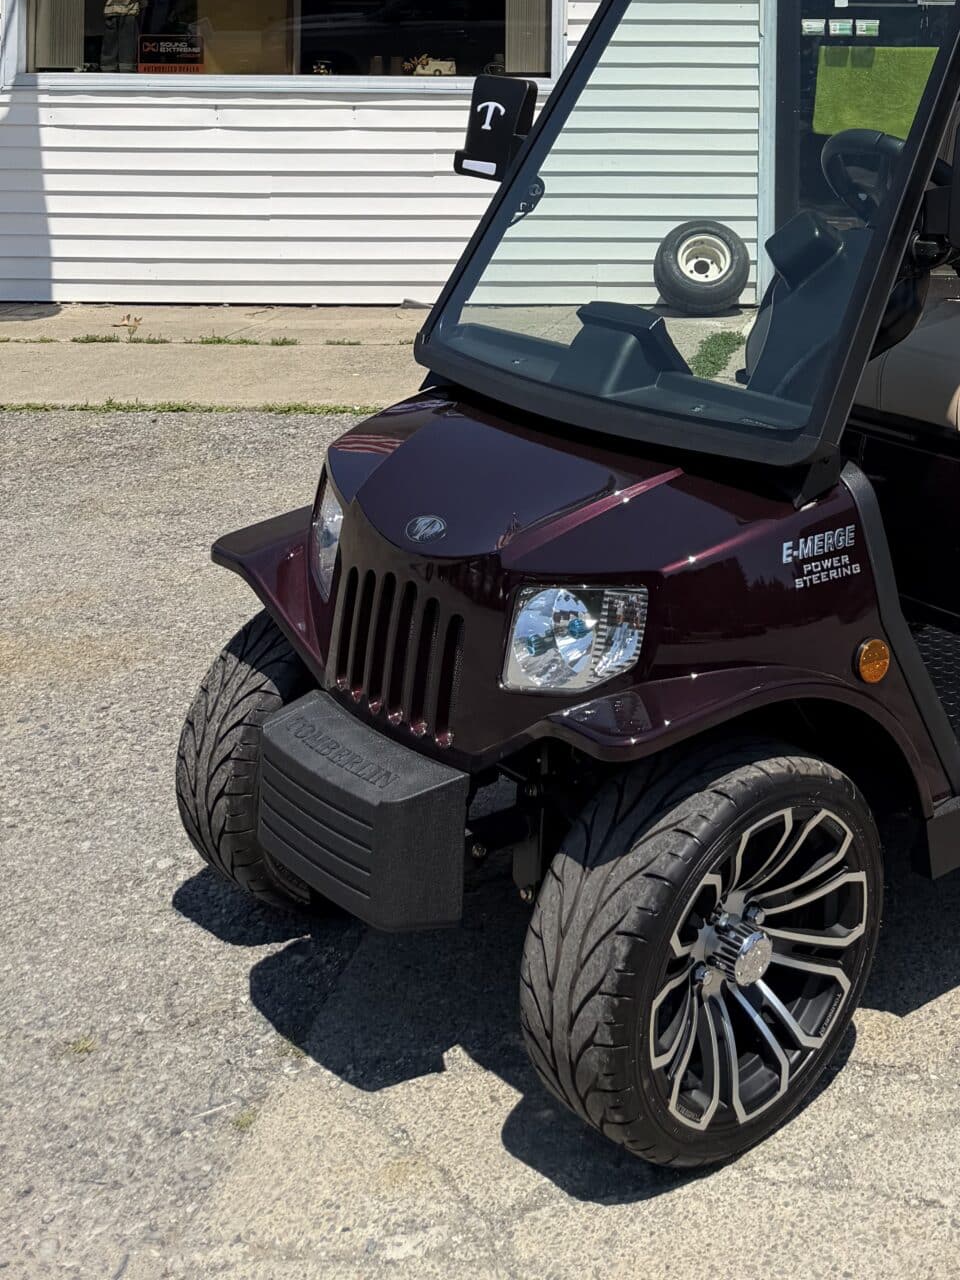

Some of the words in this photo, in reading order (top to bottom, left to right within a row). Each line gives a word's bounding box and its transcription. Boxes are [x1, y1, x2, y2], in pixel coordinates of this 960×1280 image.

[782, 524, 856, 564] E-MERGE
[795, 563, 861, 589] STEERING
[803, 554, 850, 575] POWER
[286, 715, 401, 790] TOMBERLIN
